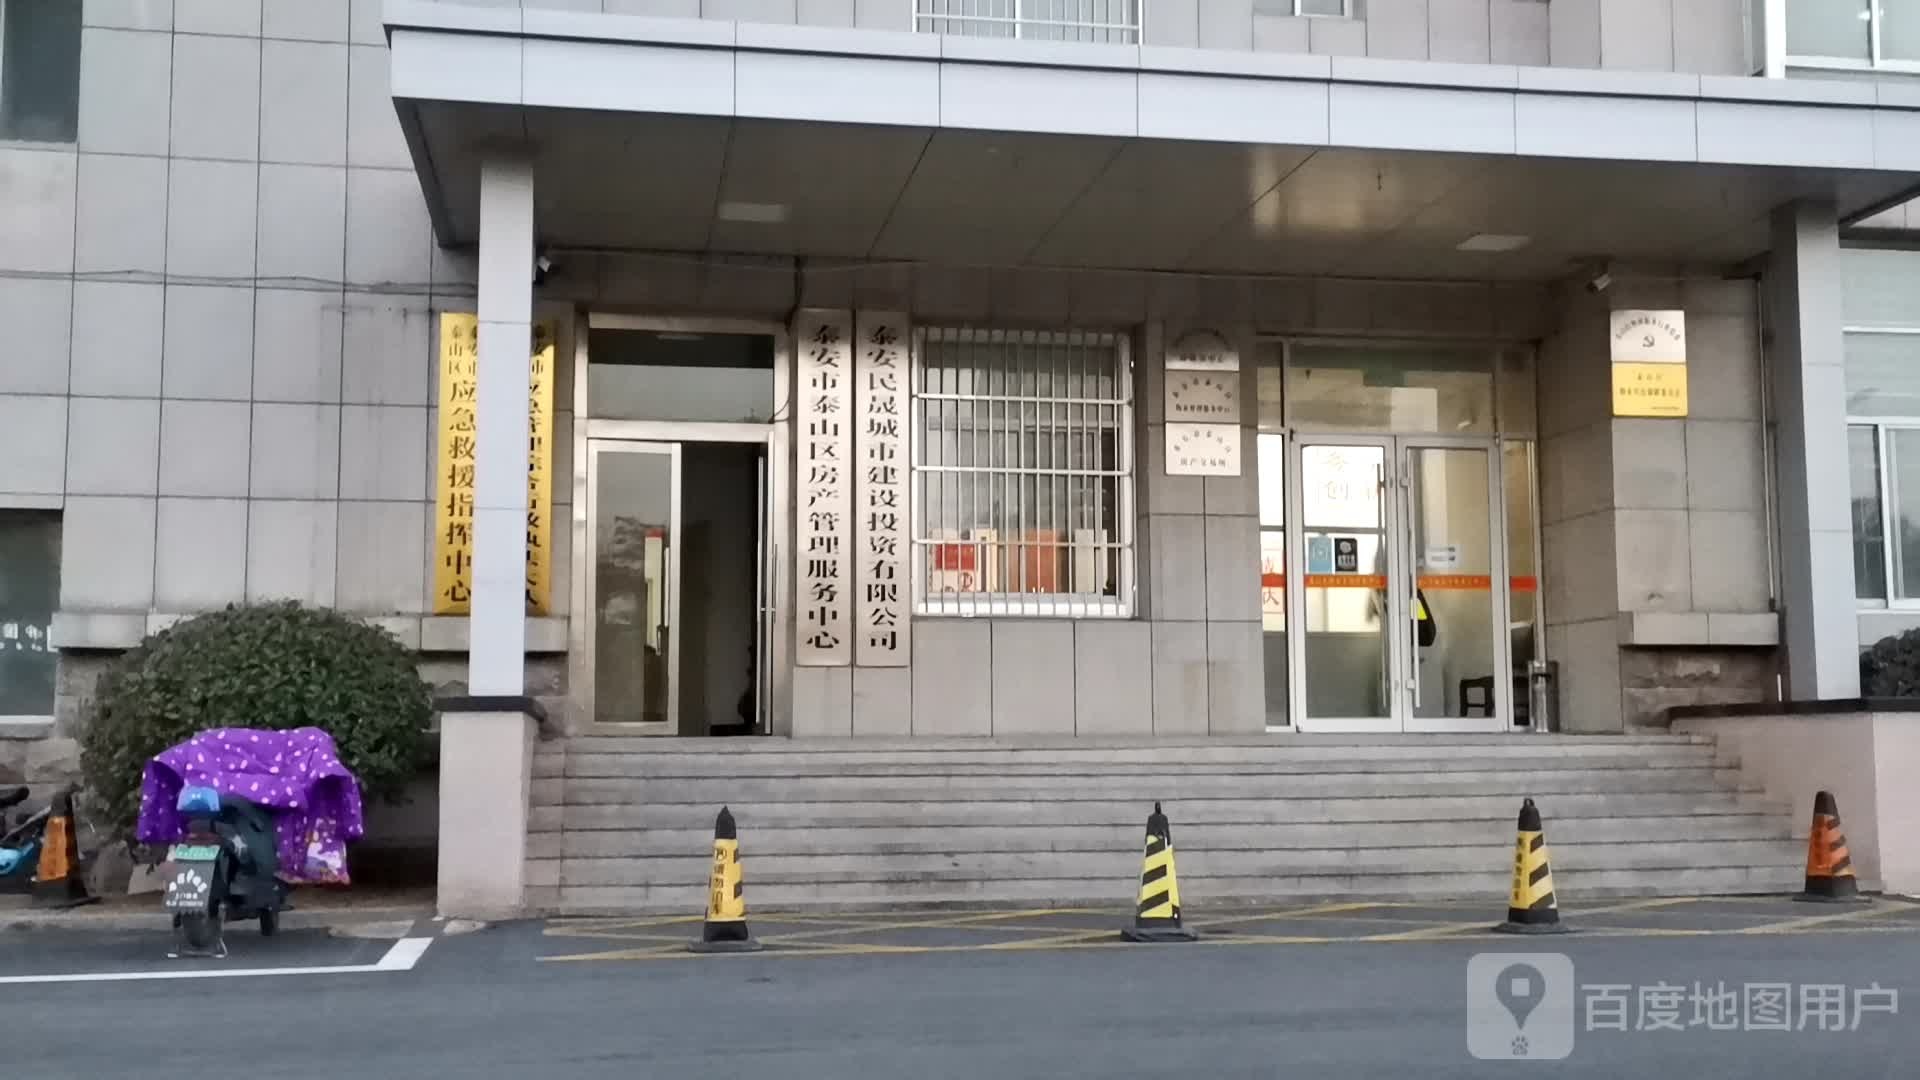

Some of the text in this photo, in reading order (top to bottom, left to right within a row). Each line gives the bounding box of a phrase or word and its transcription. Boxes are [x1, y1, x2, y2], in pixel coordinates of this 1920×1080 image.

[807, 325, 840, 649] 泰安市泰山区房产管理服务中心
[866, 325, 899, 651] 泰安民晟城市建设投资有限公司
